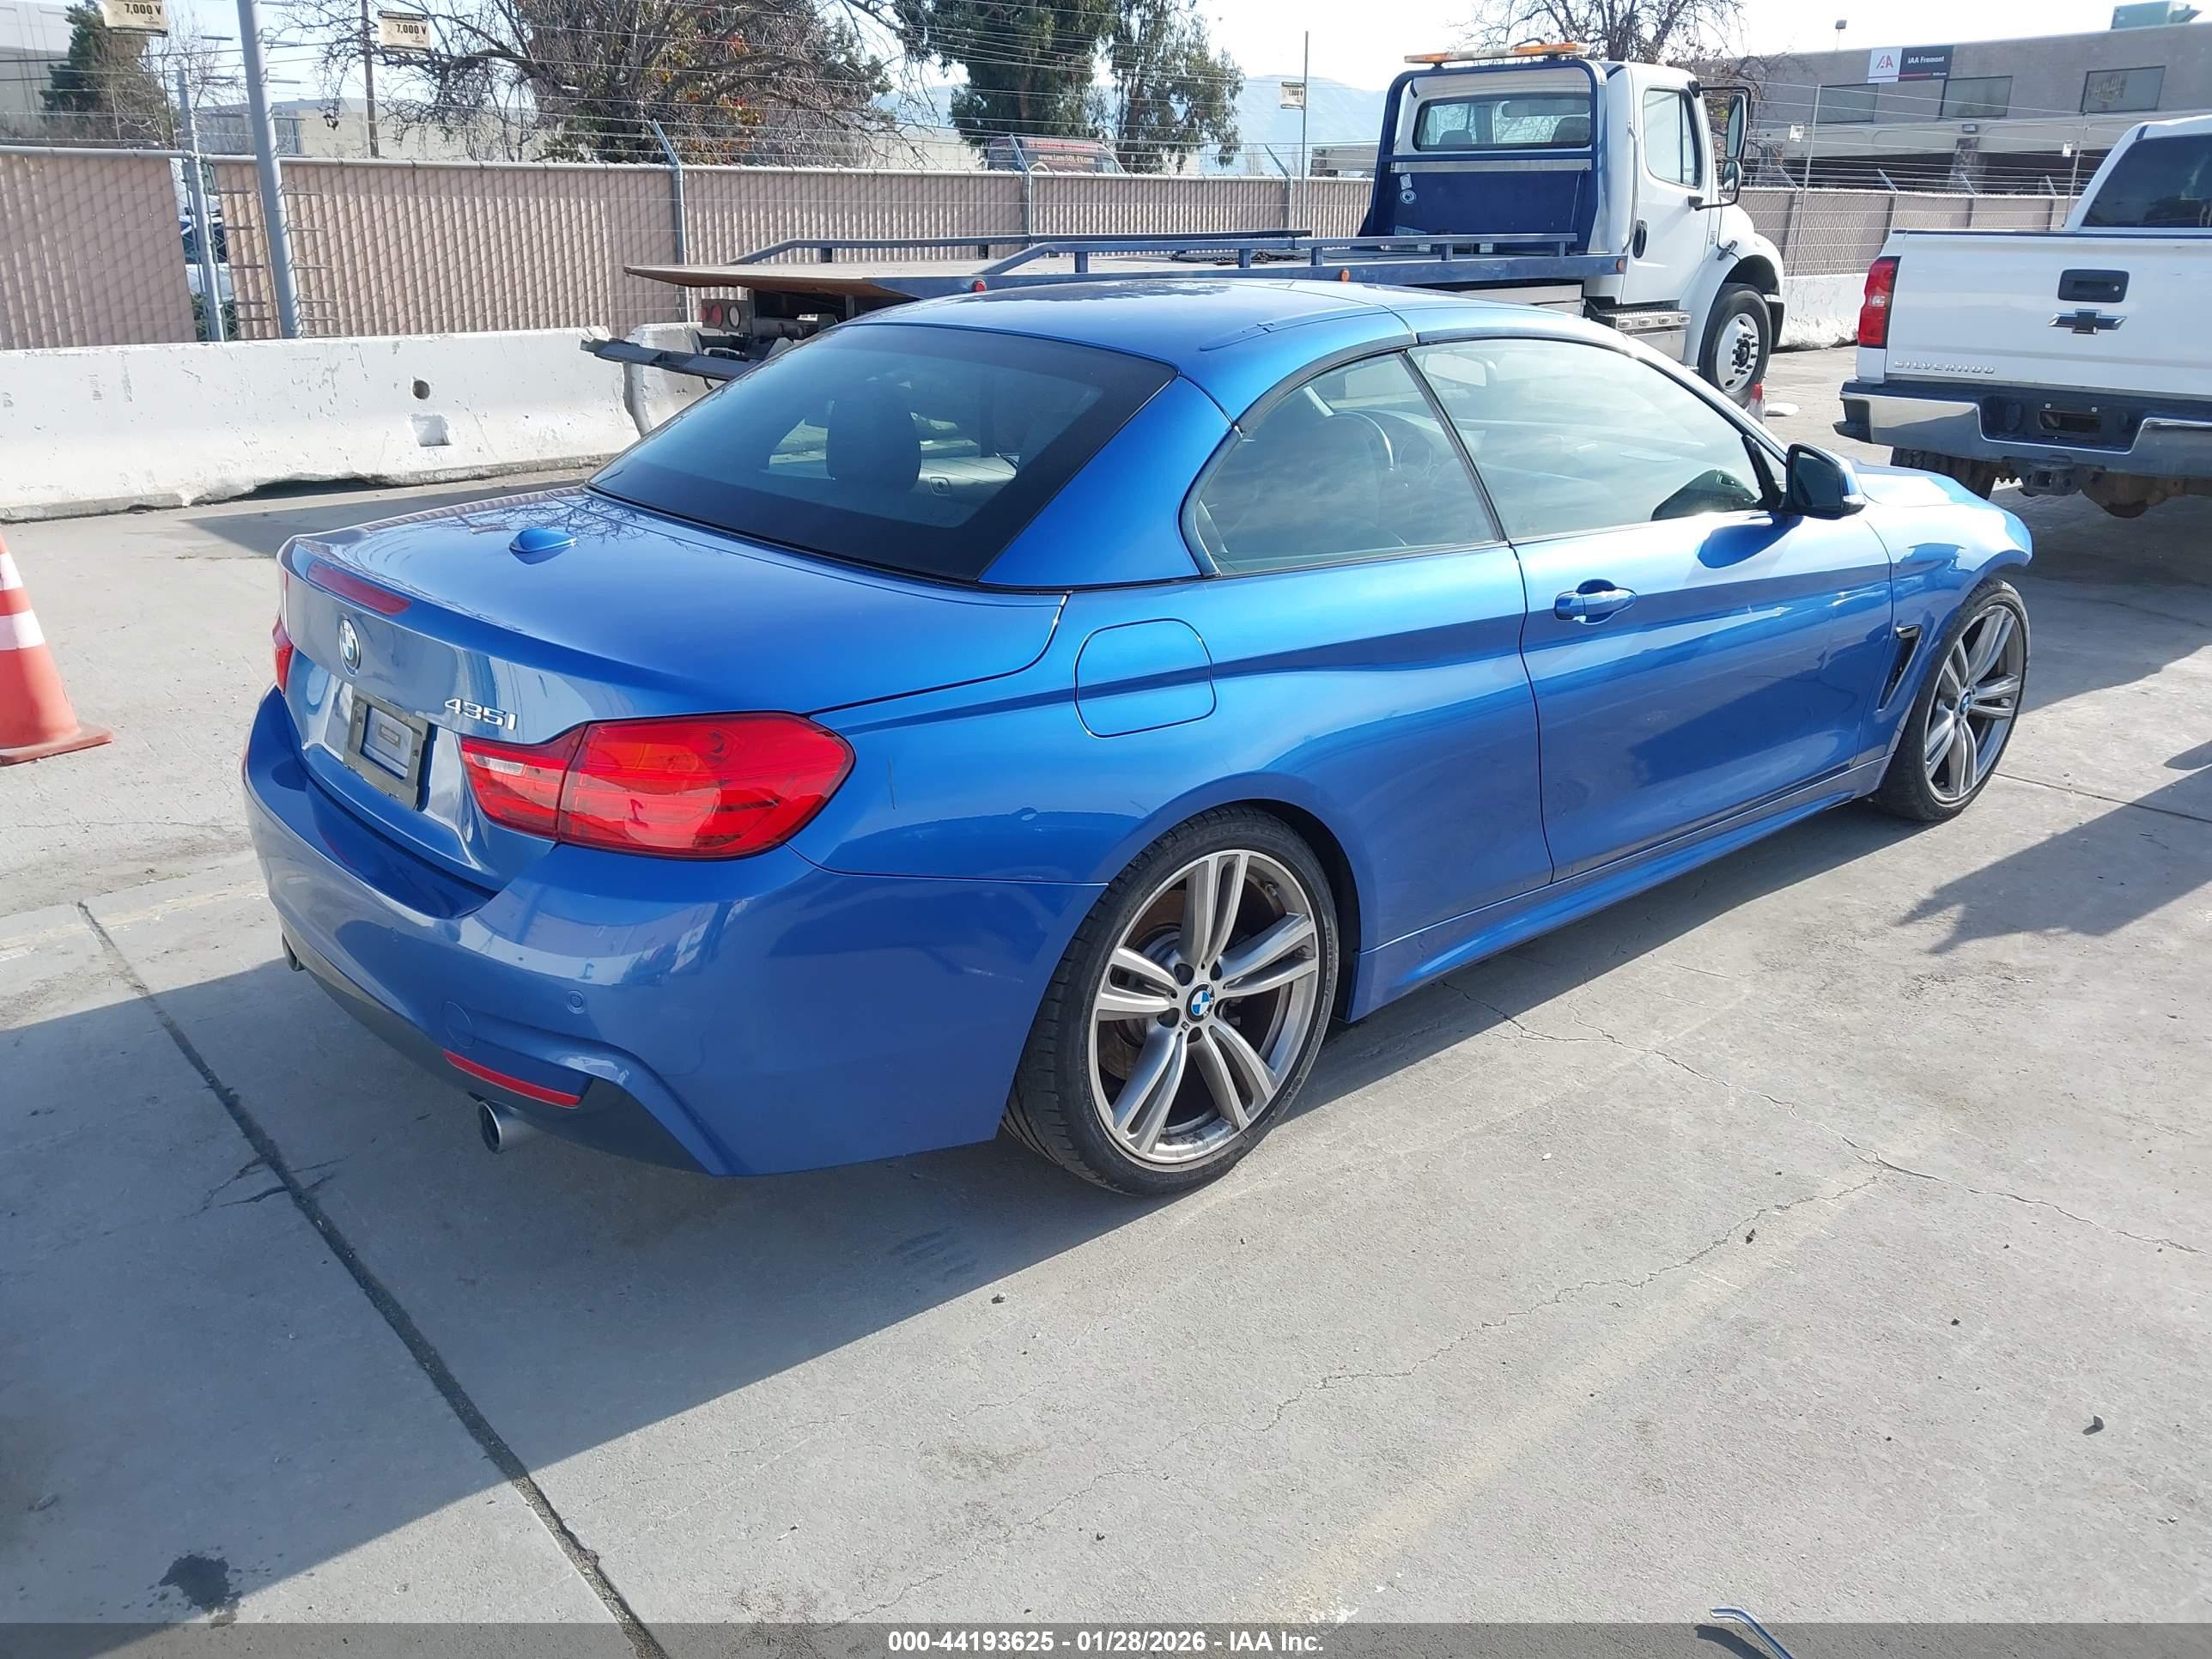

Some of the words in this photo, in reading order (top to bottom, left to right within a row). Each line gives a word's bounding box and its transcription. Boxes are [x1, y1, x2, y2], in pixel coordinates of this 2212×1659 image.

[124, 3, 153, 15] 7,000
[155, 5, 161, 15] V
[421, 25, 427, 35] V
[1907, 56, 1919, 64] IAA
[1920, 55, 1945, 64] Fremont
[1893, 360, 1996, 375] SILVERADO
